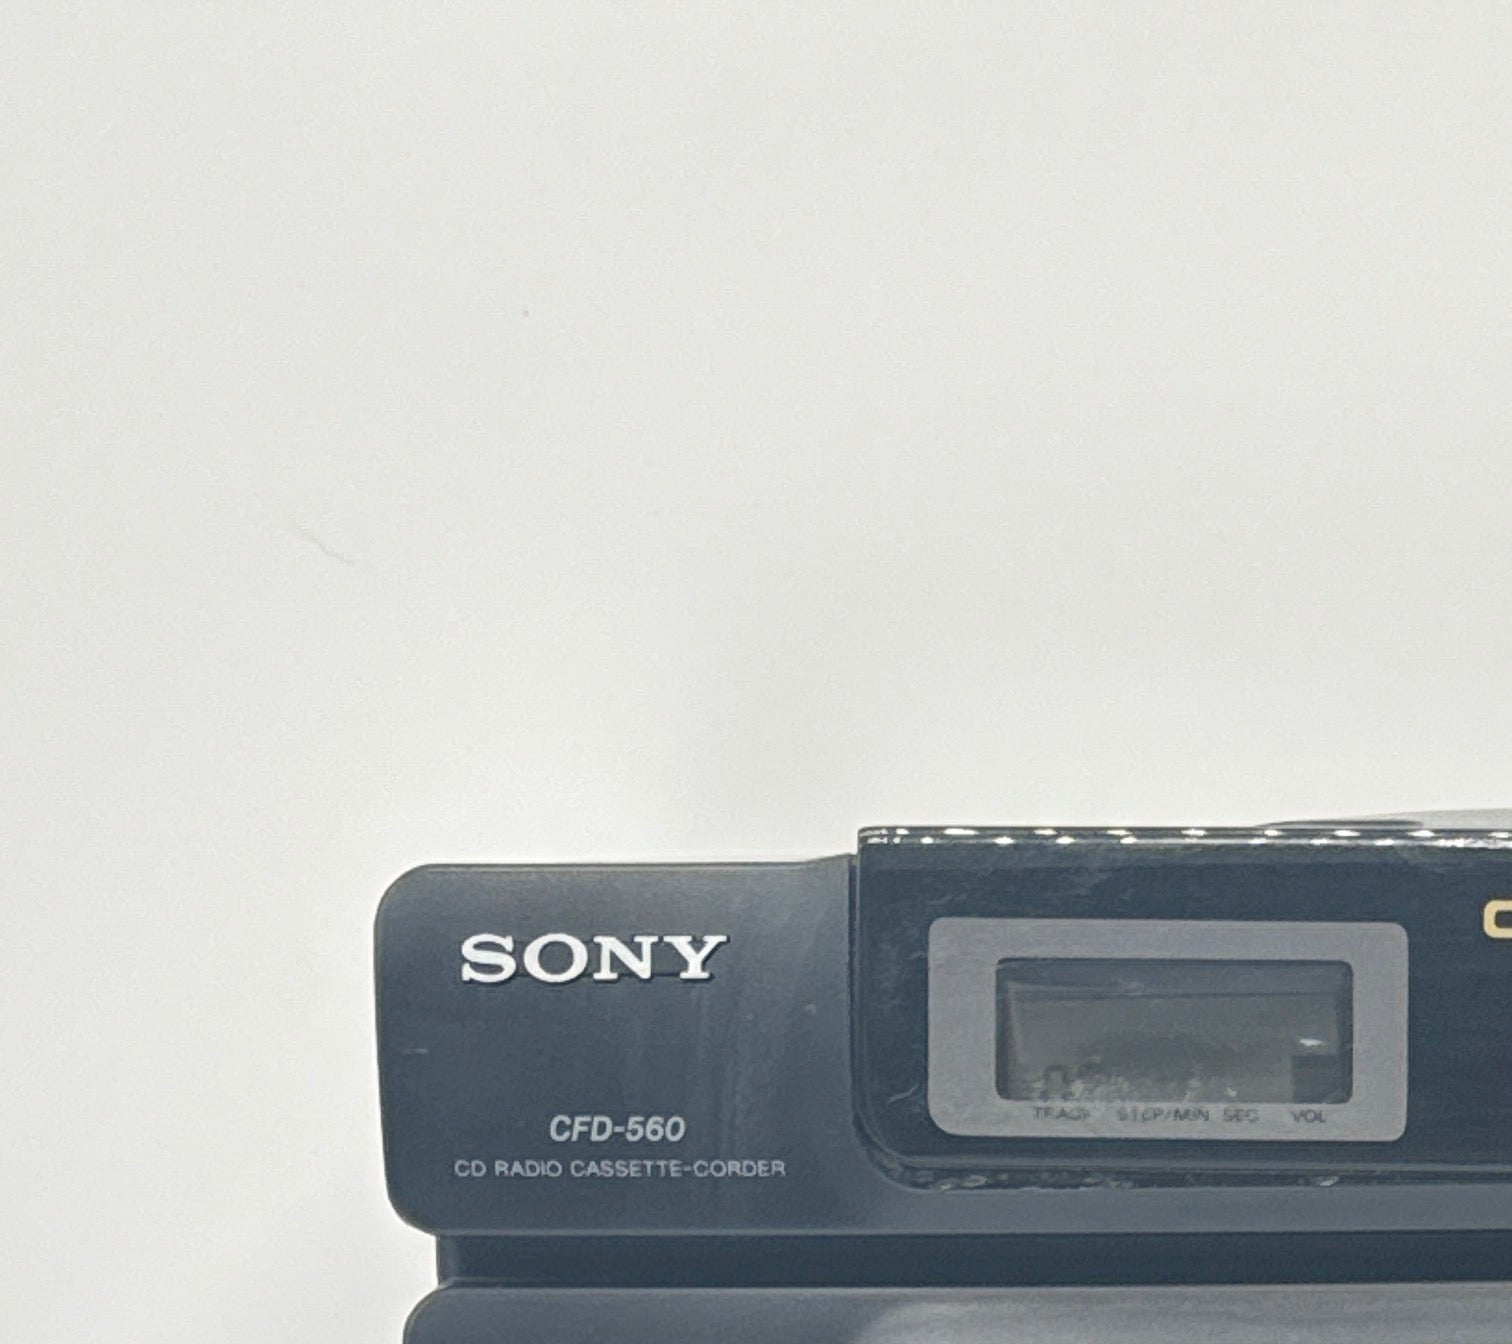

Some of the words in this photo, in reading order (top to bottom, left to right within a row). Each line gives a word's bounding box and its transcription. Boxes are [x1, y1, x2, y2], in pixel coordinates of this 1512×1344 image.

[460, 933, 728, 983] SONY
[549, 1114, 686, 1143] CFD-560
[1290, 1110, 1326, 1124] VOL
[454, 1159, 487, 1177] CD
[494, 1159, 563, 1178] RADIO
[570, 1159, 786, 1179] CASSETTE-CORDER
